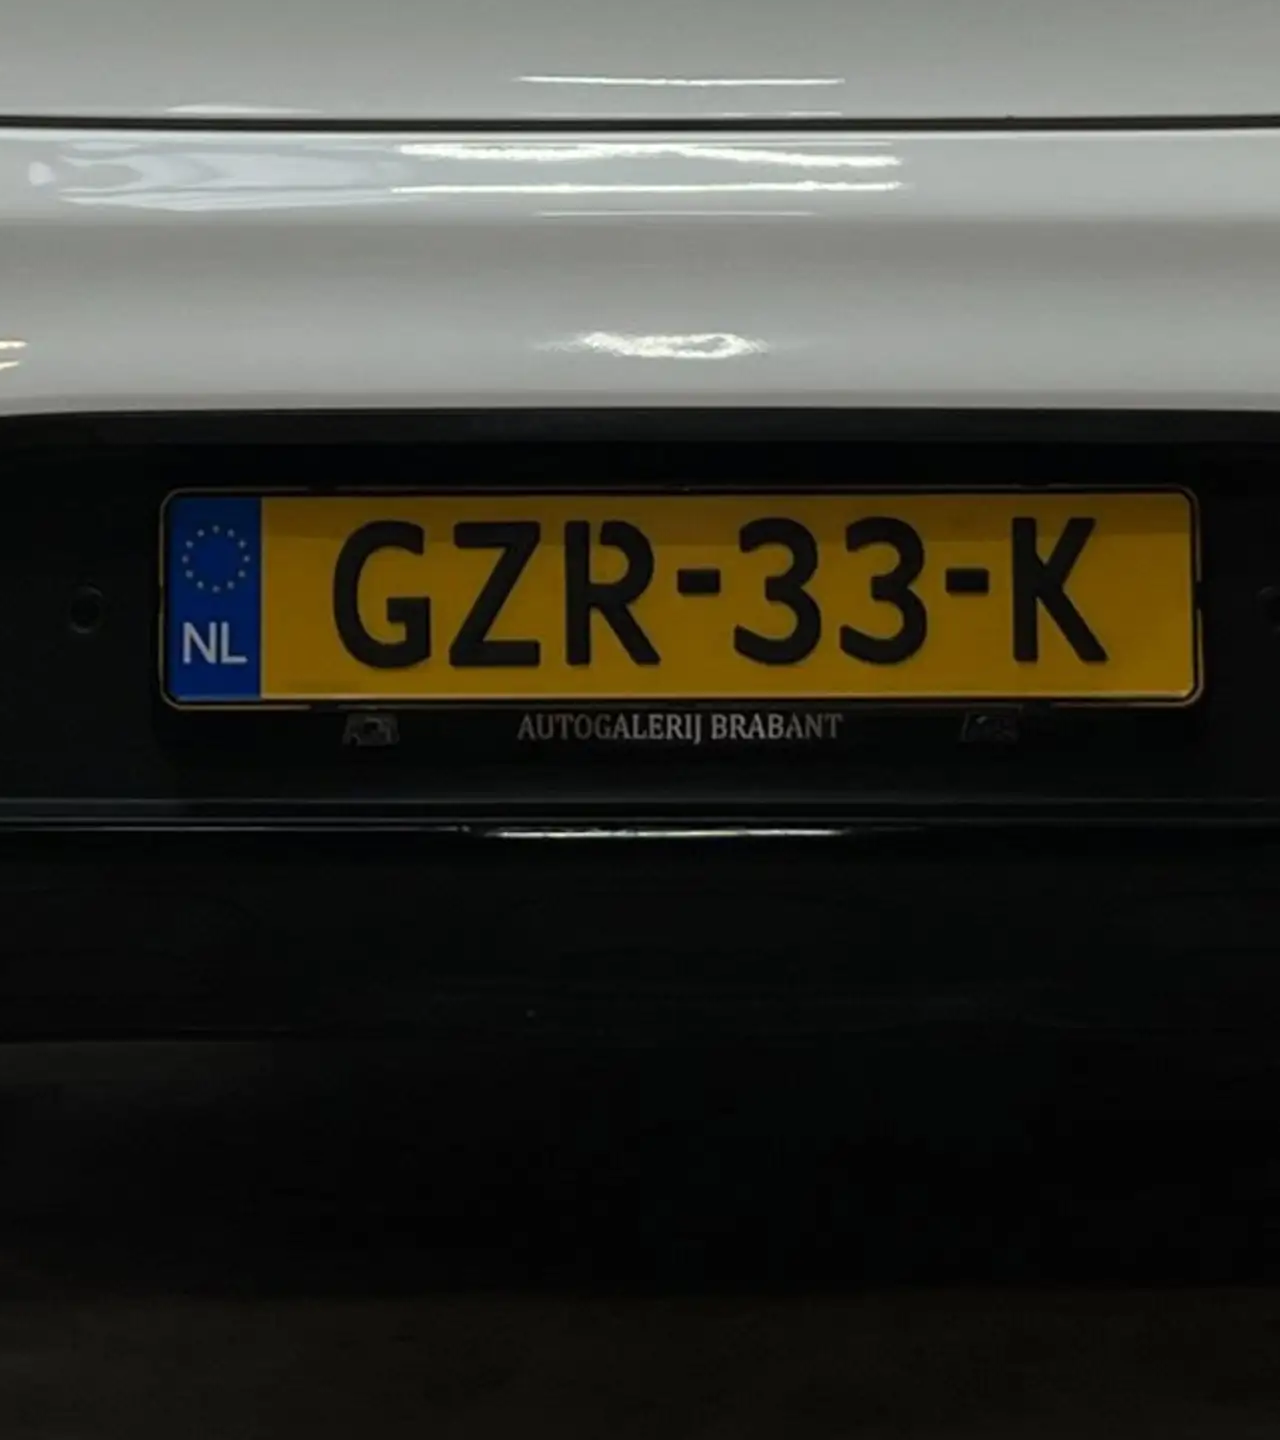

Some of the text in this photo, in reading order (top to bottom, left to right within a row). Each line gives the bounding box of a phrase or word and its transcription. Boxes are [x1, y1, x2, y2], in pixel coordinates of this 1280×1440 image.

[333, 517, 1108, 668] GZR-33-K
[181, 621, 247, 664] NL
[517, 712, 843, 744] AUTOGALERIJ BRABANT
